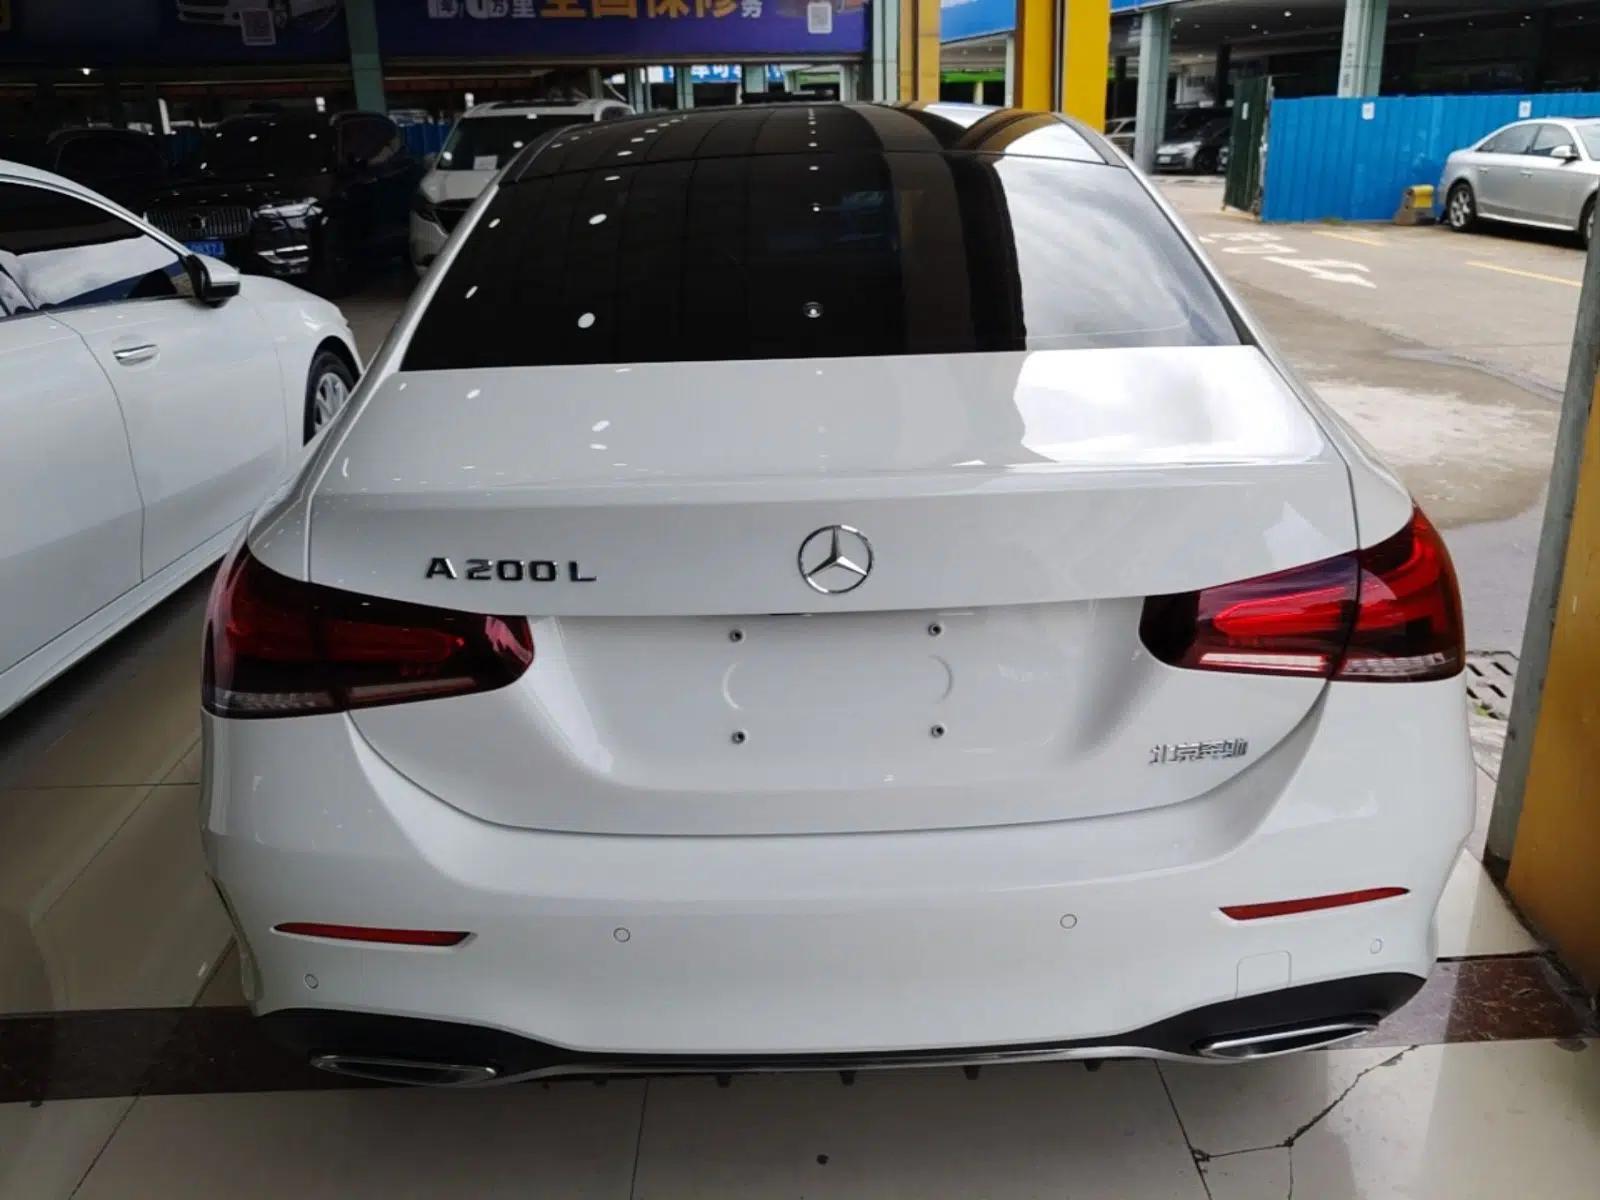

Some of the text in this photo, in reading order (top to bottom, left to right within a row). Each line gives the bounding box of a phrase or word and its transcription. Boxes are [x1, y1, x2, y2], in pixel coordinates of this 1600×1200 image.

[425, 557, 597, 582] A 200 L
